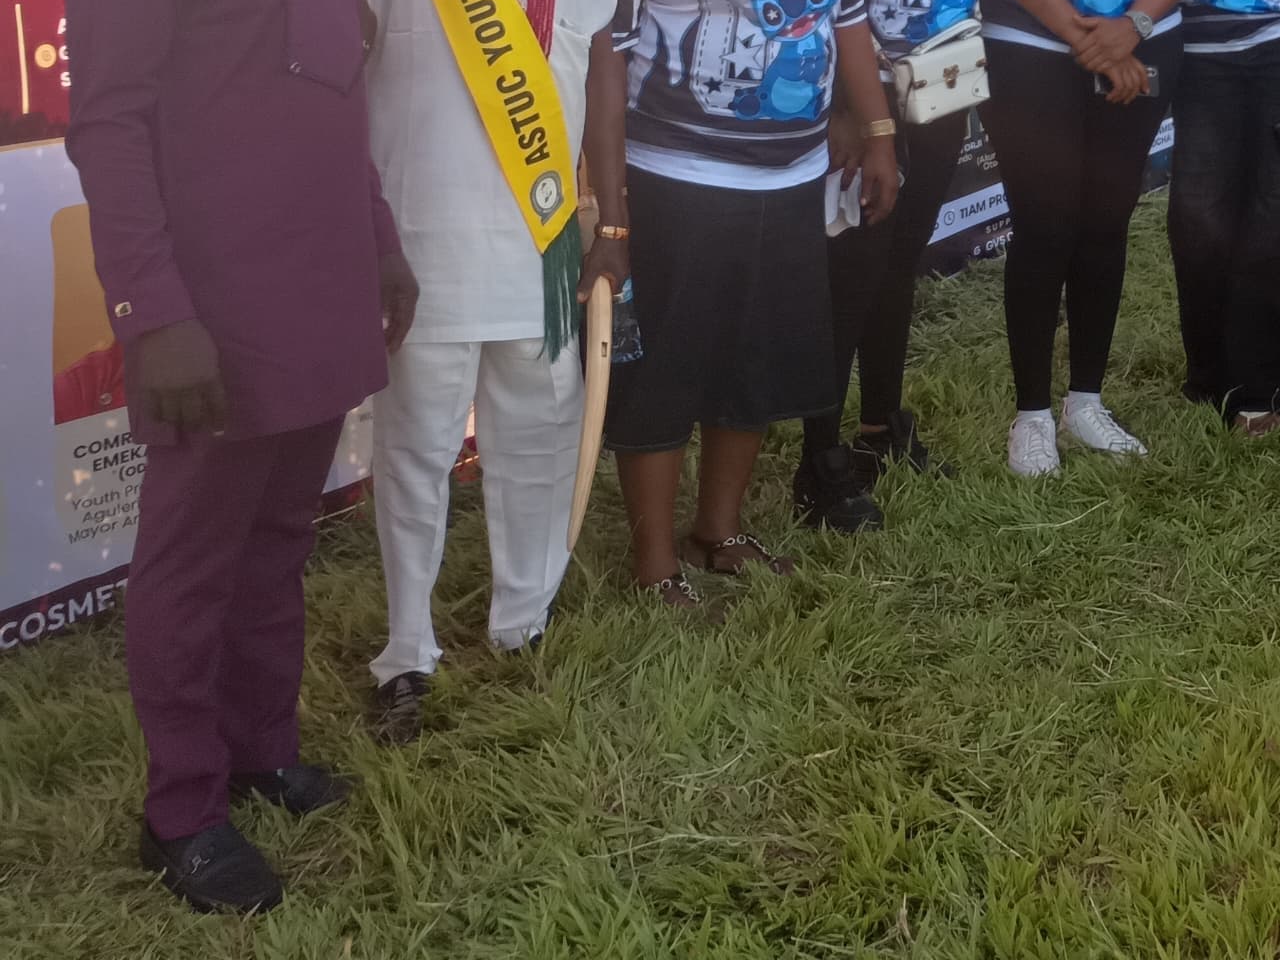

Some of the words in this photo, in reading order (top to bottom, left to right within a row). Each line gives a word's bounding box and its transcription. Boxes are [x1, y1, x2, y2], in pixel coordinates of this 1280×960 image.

[495, 68, 551, 167] ASTUC
[960, 200, 987, 219] 11AM
[71, 487, 121, 512] Youth
[81, 496, 141, 526] Aguler
[68, 520, 119, 546] Mayor
